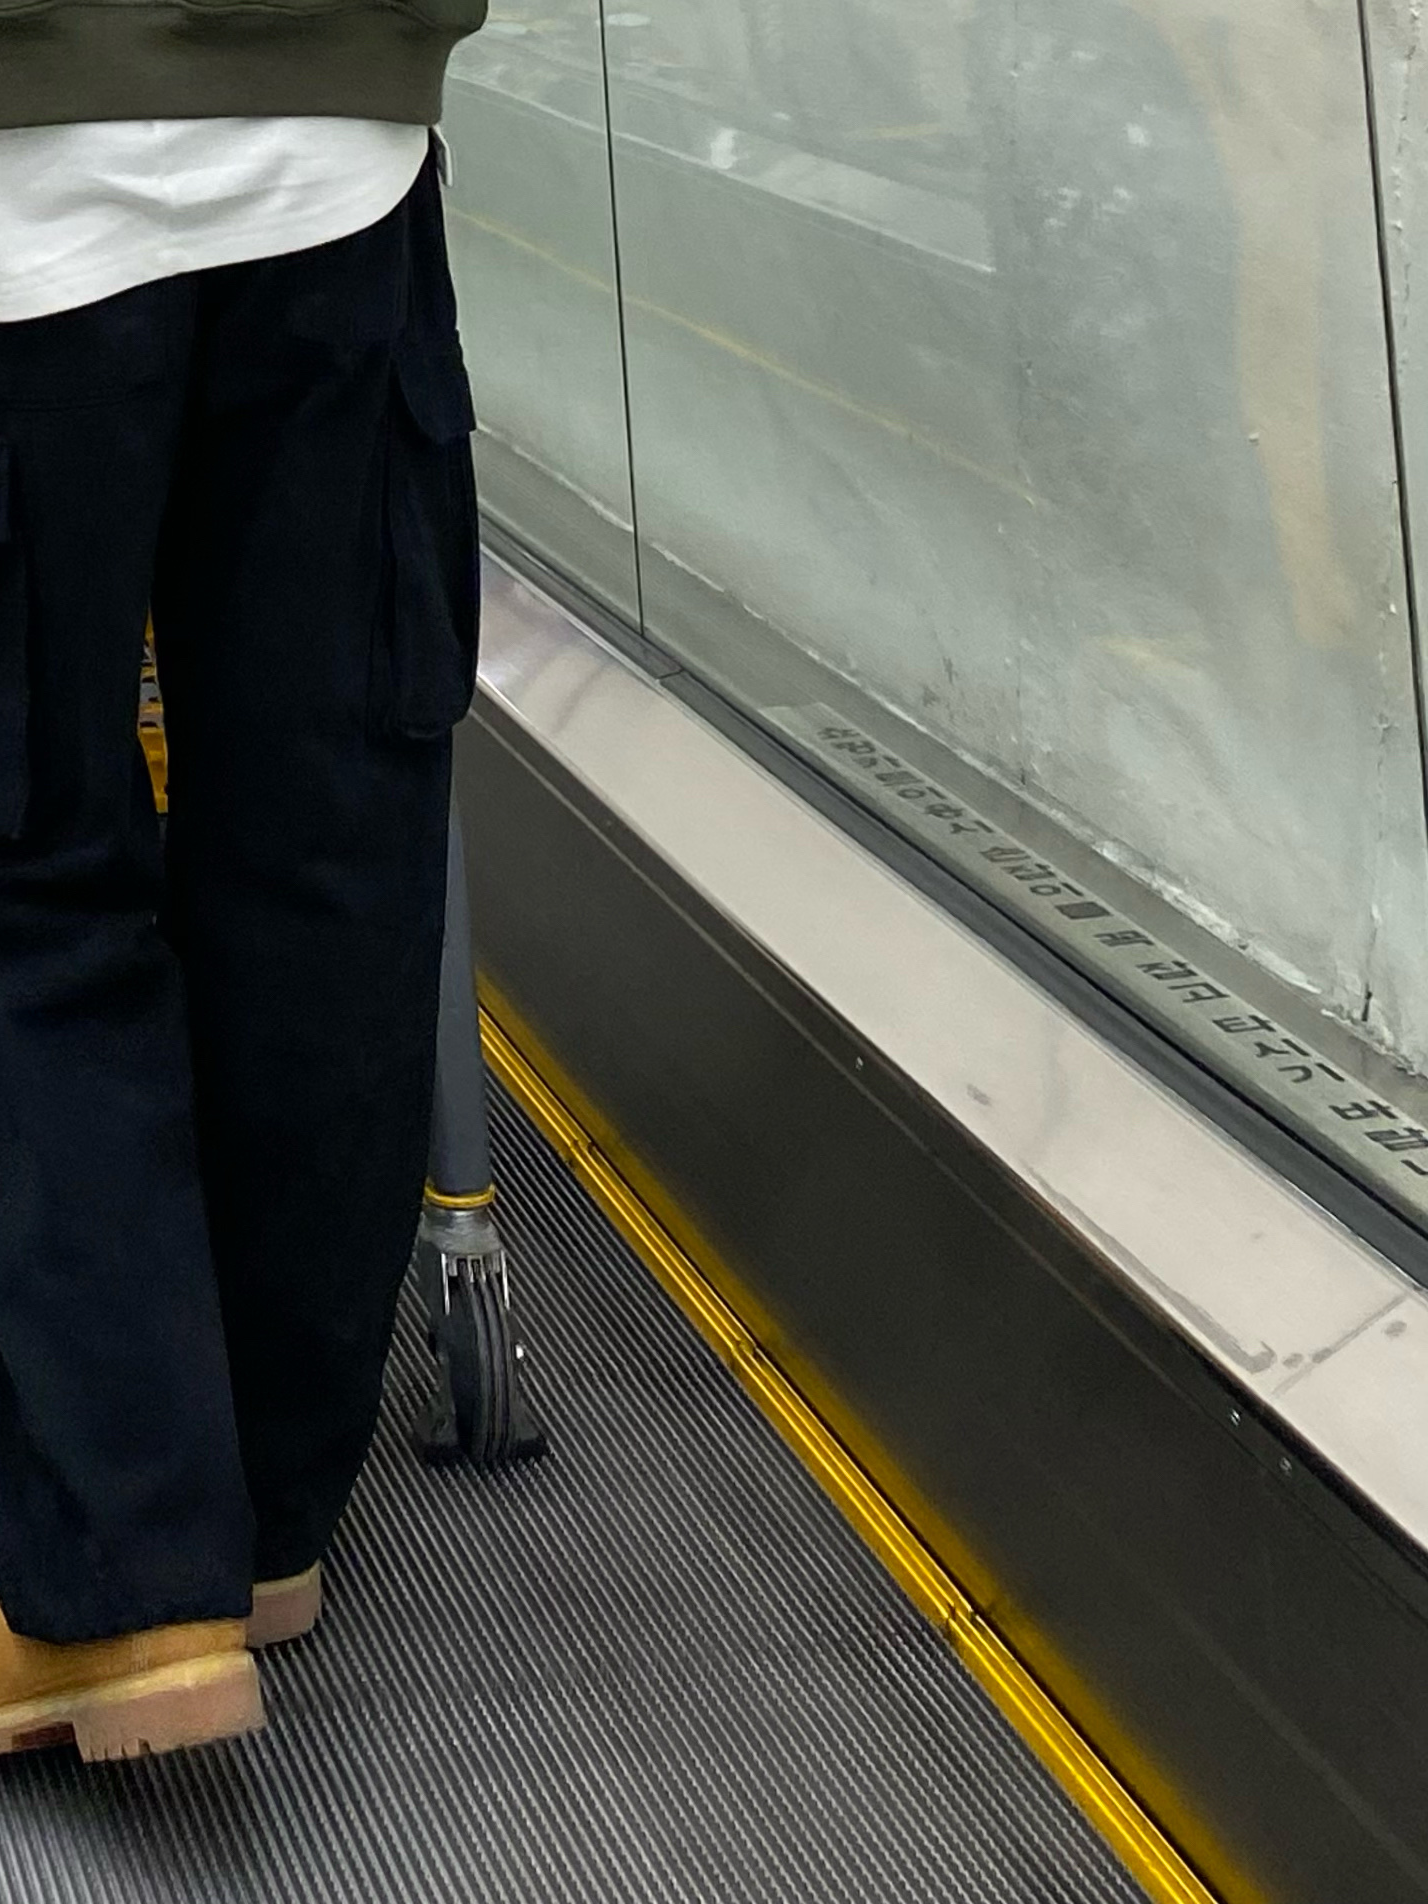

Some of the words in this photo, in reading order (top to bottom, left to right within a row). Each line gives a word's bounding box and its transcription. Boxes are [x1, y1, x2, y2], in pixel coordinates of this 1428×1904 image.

[979, 846, 1115, 920] 손잡이를
[1092, 929, 1156, 948] 꼭
[1135, 960, 1232, 1004] 잡고
[1211, 1014, 1346, 1084] 타시기
